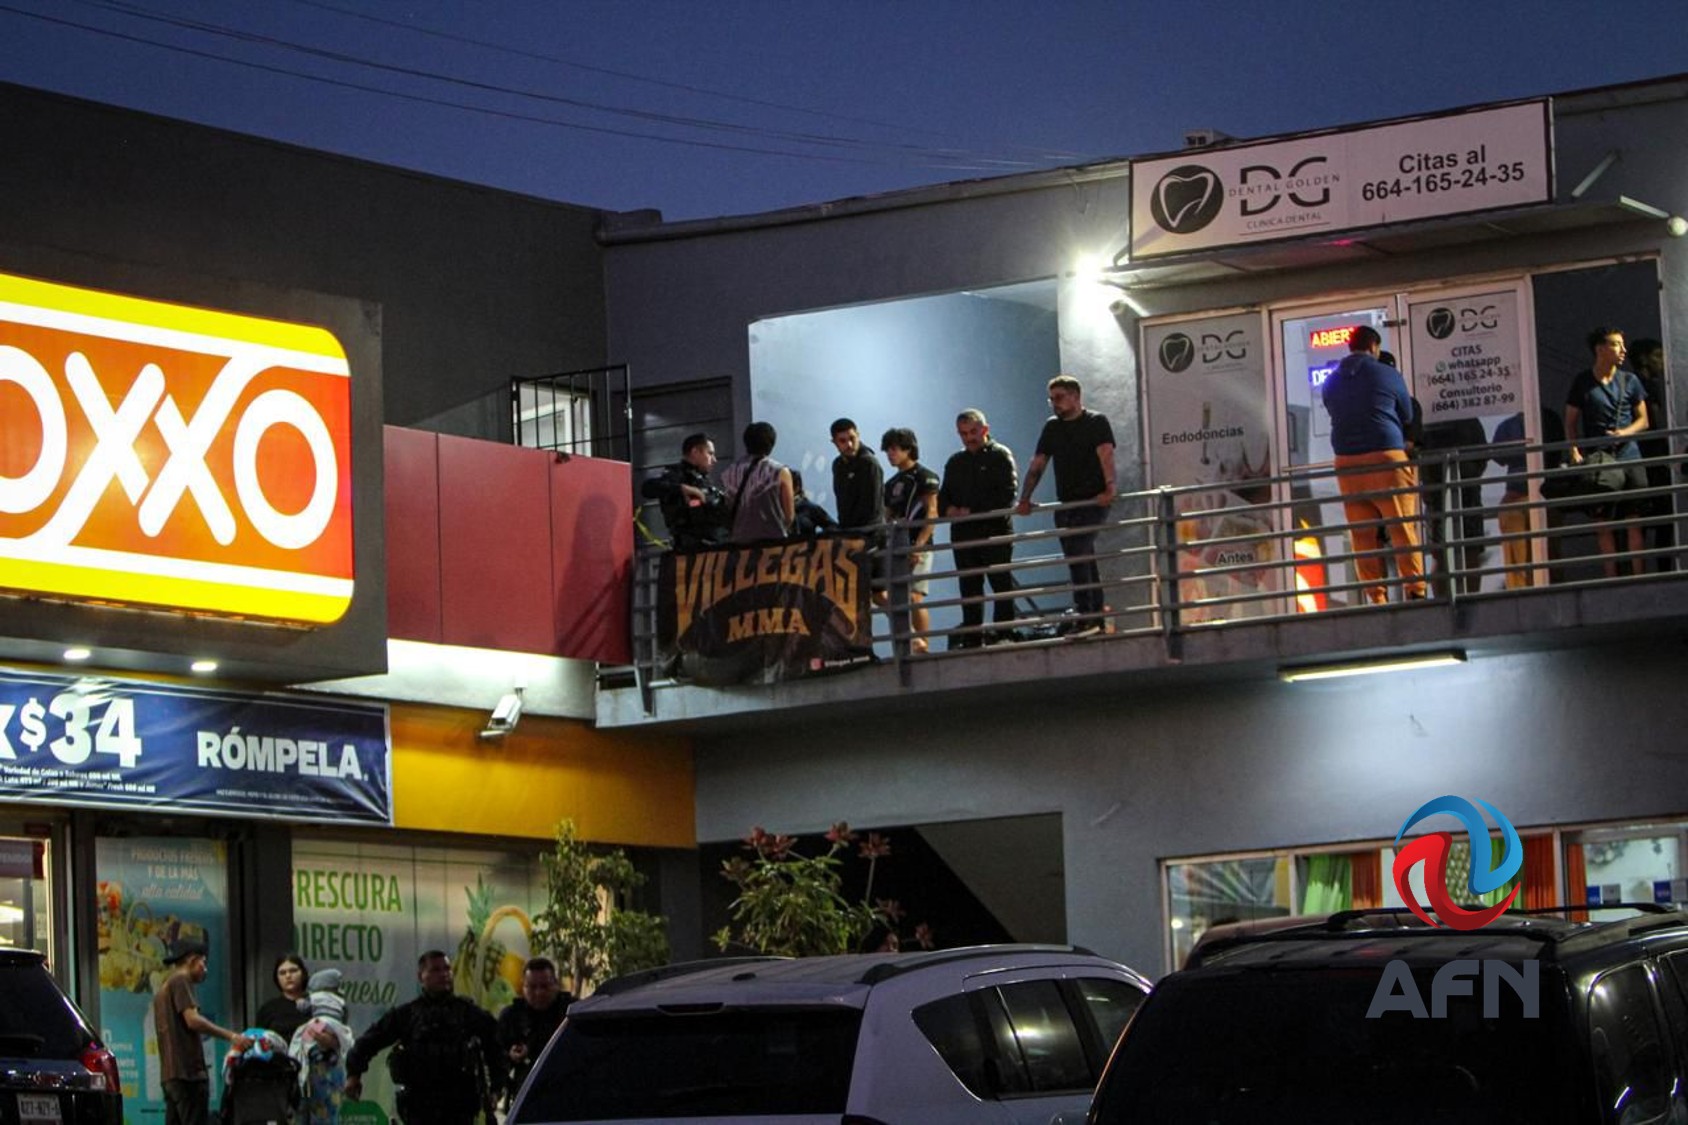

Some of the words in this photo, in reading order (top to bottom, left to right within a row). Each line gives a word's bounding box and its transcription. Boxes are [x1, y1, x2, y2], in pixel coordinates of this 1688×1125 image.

[1399, 153, 1458, 174] Citas
[1466, 144, 1486, 165] al
[1228, 183, 1280, 197] DENTAL
[1286, 174, 1341, 189] GOLDEN
[1362, 161, 1525, 201] 664-165-24-35
[1284, 211, 1323, 224] DENTAL
[1312, 327, 1355, 348] ABIER
[1451, 344, 1482, 357] CITAS
[1448, 356, 1501, 370] whatsapp
[1428, 373, 1455, 387] (664)
[1459, 369, 1478, 381] 165
[1480, 366, 1510, 379] 24-35
[1440, 383, 1503, 399] Consultorio
[1432, 400, 1459, 413] (664)
[1483, 393, 1515, 406] 87-99
[1162, 425, 1245, 445] Endodoncias
[0, 345, 338, 550] OXXO
[1218, 551, 1254, 565] Antes
[675, 538, 866, 643] VILLEGAS
[727, 607, 811, 643] MMA
[20, 692, 142, 768] $34
[197, 726, 369, 781] RÓMPELA.
[168, 866, 179, 879] LA
[295, 868, 402, 913] RESCURA
